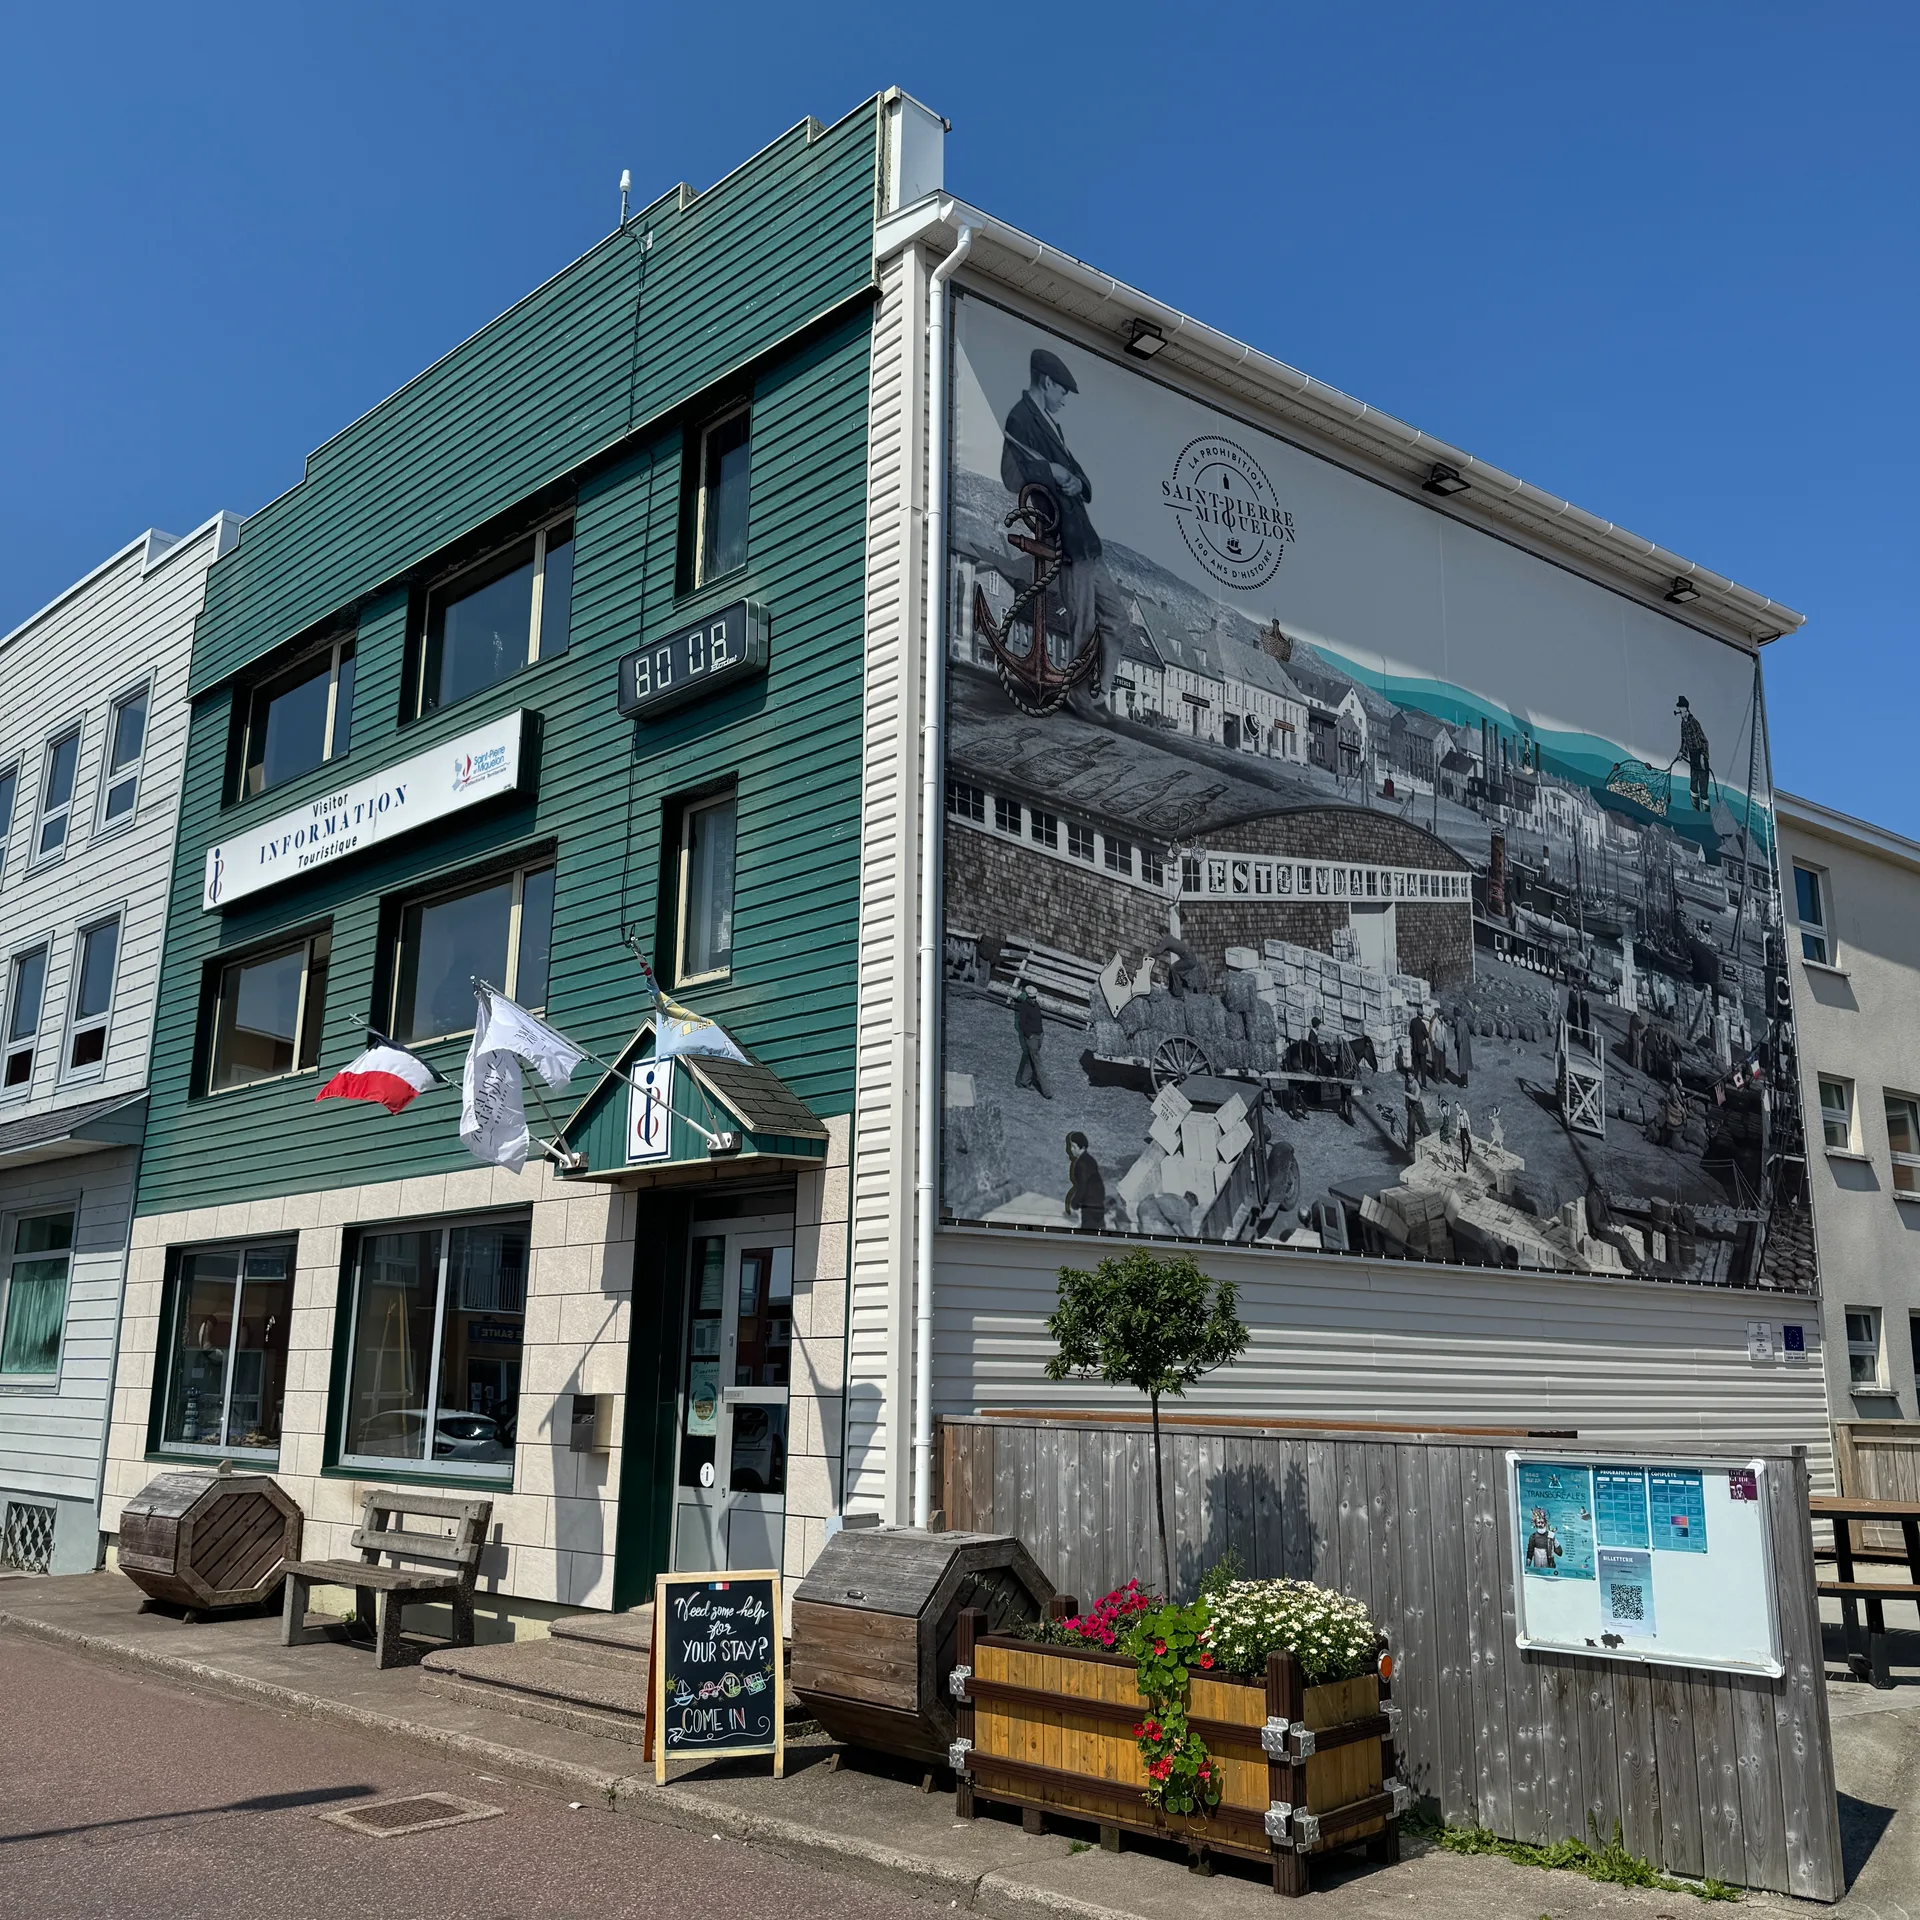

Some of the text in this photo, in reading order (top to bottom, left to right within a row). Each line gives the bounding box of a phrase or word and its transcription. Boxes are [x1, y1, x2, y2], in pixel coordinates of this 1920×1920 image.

[1188, 447, 1263, 490] LA PROHIBITION
[1161, 480, 1294, 528] SAINT-PIERRE
[1195, 503, 1295, 543] MIQUELON
[1194, 537, 1273, 578] 100 ANS D'HISTOIRE
[313, 793, 349, 817] Visitor
[260, 784, 408, 864] INFORMATION
[298, 835, 358, 868] Touristique
[1603, 1555, 1634, 1563] BILLETTERIE
[674, 1591, 769, 1625] Need some help
[707, 1620, 737, 1640] for
[683, 1636, 769, 1663] YOUR STAY?
[681, 1707, 747, 1734] COME IN
